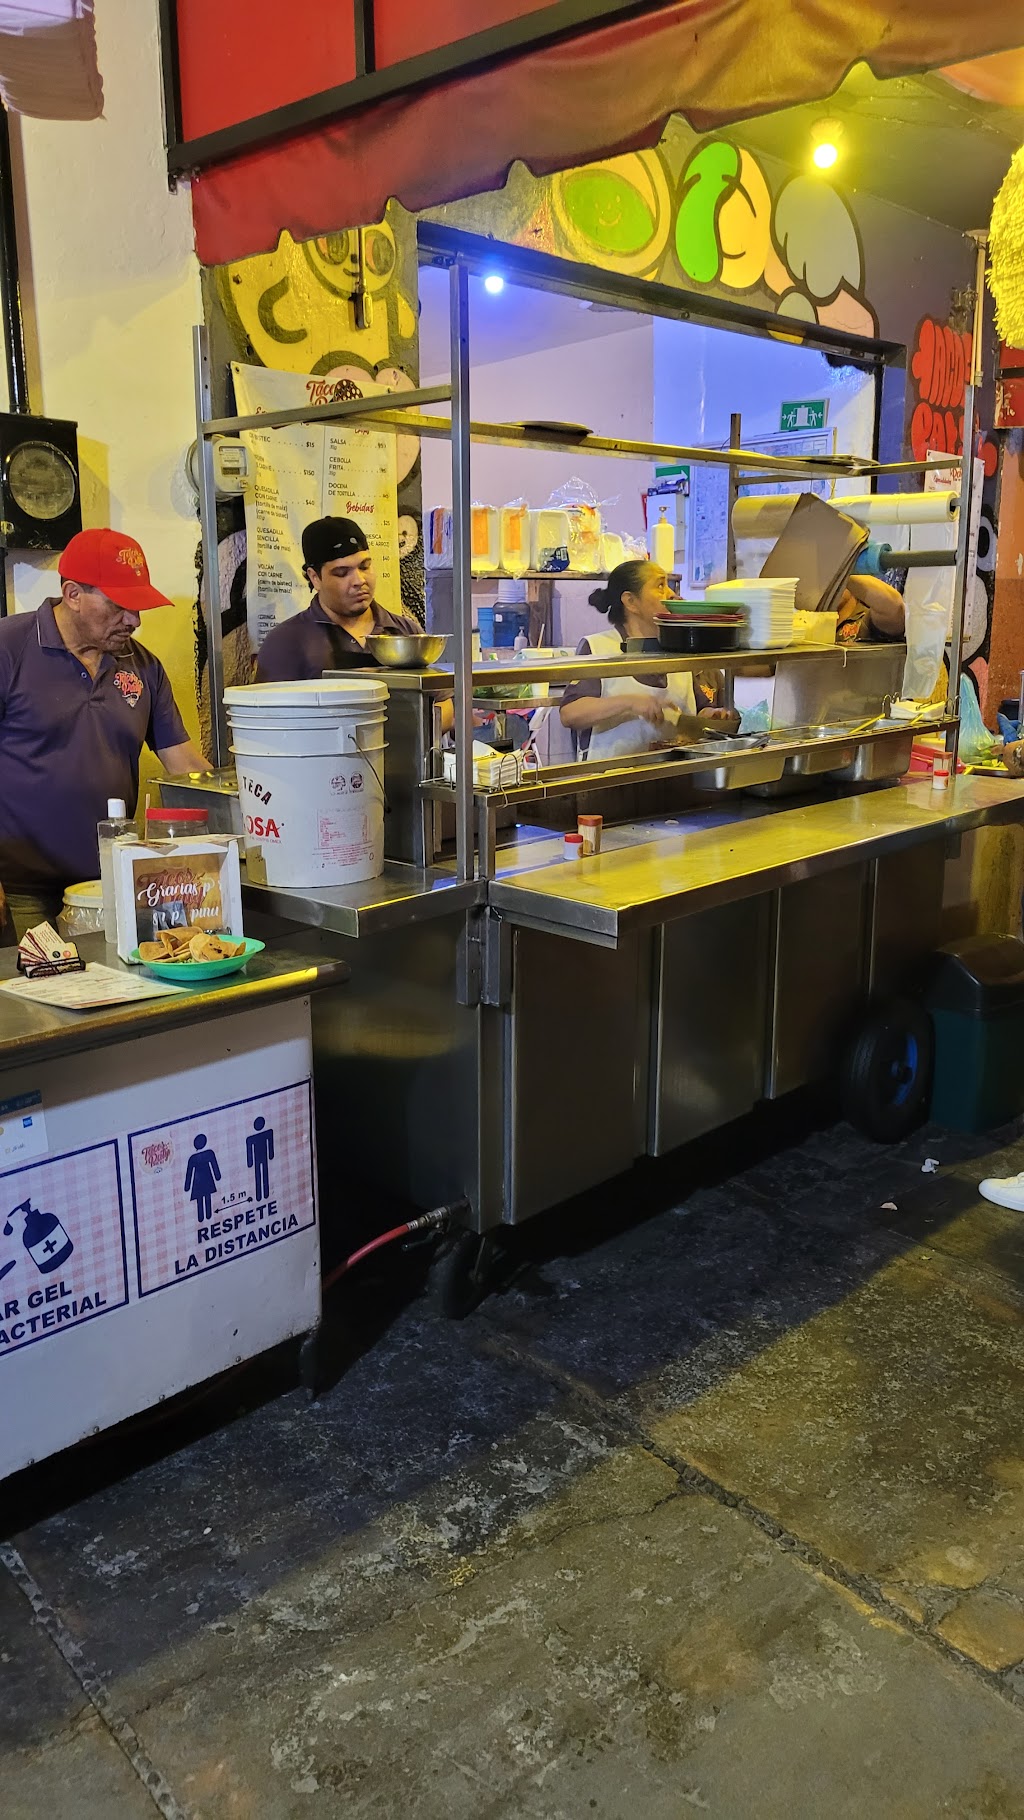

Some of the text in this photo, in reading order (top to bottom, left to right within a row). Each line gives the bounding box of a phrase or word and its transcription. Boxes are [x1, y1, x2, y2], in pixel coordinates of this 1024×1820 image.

[329, 456, 351, 464] CEBOLLA
[346, 500, 375, 514] Bebidas
[221, 1190, 247, 1205] 1.5 m
[197, 1201, 278, 1244] RESPETE
[174, 1213, 299, 1275] LA DISTANCIA
[27, 1281, 72, 1309] GEL
